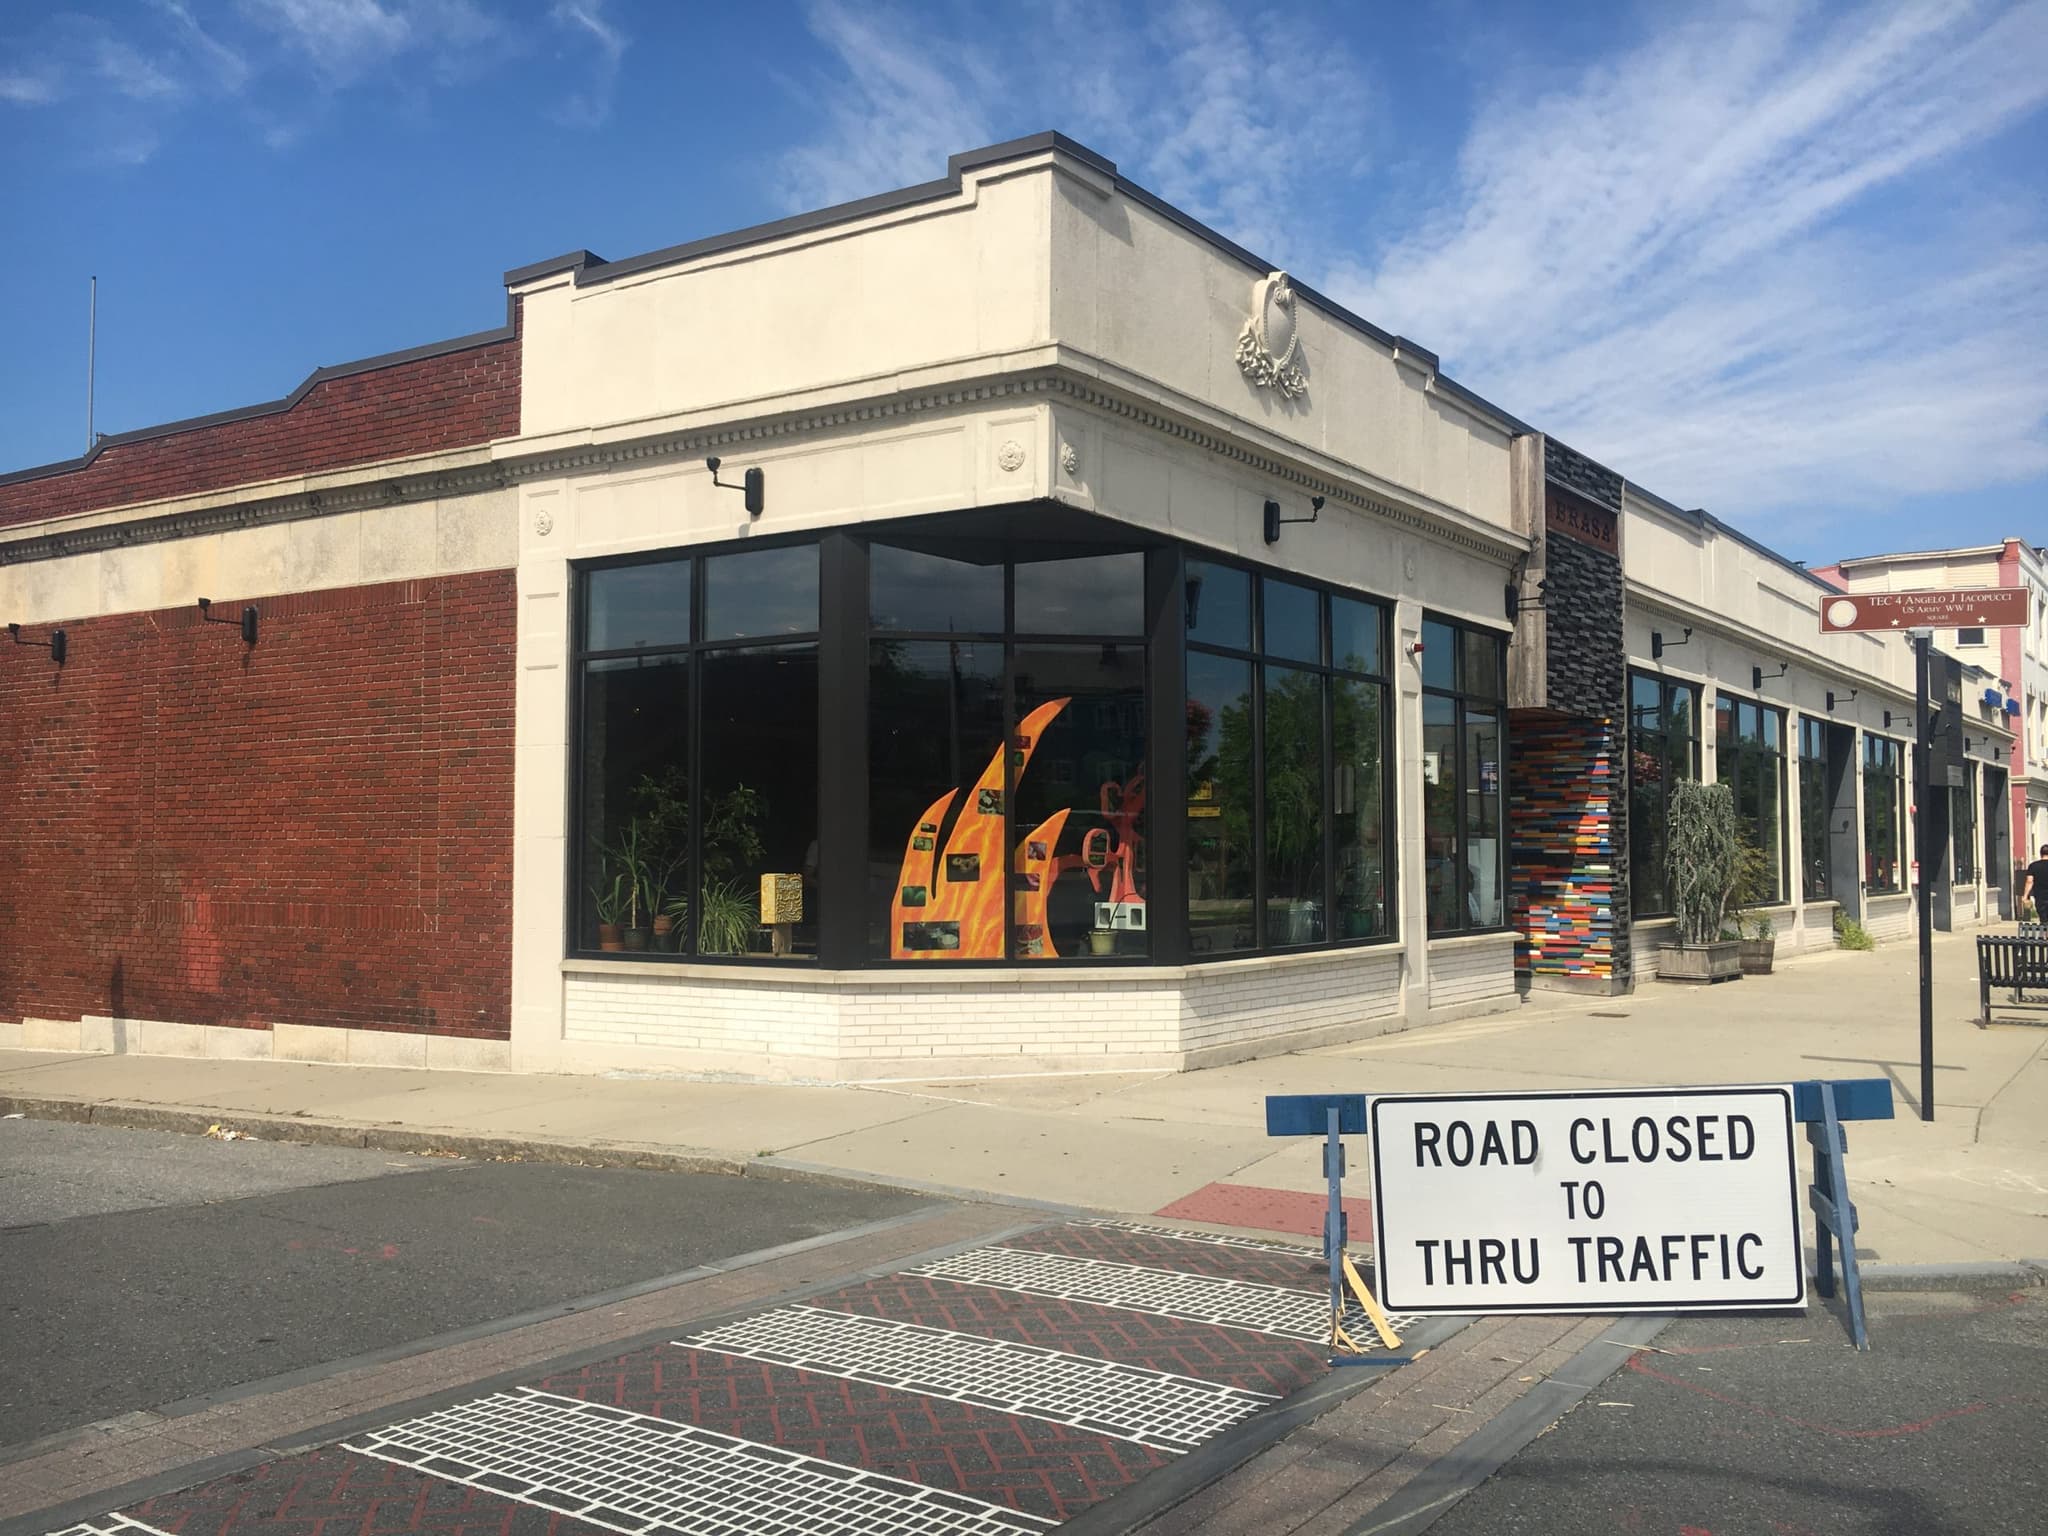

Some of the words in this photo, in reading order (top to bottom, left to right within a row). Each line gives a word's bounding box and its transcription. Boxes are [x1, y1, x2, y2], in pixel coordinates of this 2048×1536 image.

[1869, 596, 1893, 606] TEC
[1895, 596, 1902, 605] 4
[1904, 595, 1946, 605] ANGELO
[1950, 593, 1956, 603] J
[1902, 606, 1915, 614] US
[1945, 603, 1965, 612] WW
[1967, 603, 1974, 612] II
[1415, 1119, 1539, 1167] ROAD
[1569, 1114, 1755, 1164] CLOSED
[1560, 1180, 1605, 1220] TO
[1415, 1238, 1541, 1286] THRU
[1568, 1232, 1765, 1283] TRAFFIC
